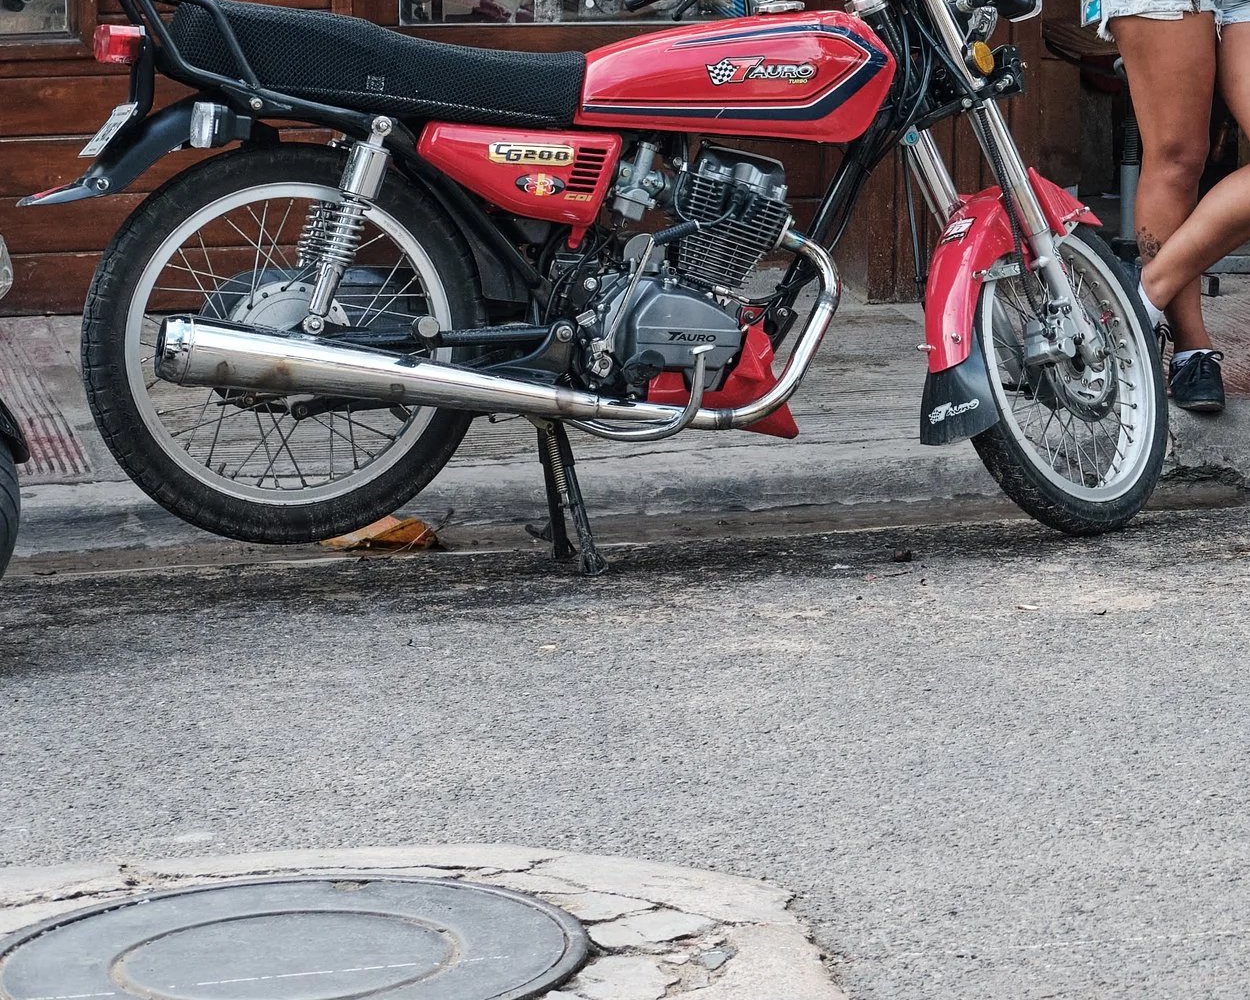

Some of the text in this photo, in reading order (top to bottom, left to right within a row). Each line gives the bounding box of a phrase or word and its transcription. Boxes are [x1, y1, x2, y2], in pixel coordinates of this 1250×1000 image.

[728, 55, 819, 83] TAURO
[563, 193, 594, 202] CDI
[667, 330, 717, 344] TAURO
